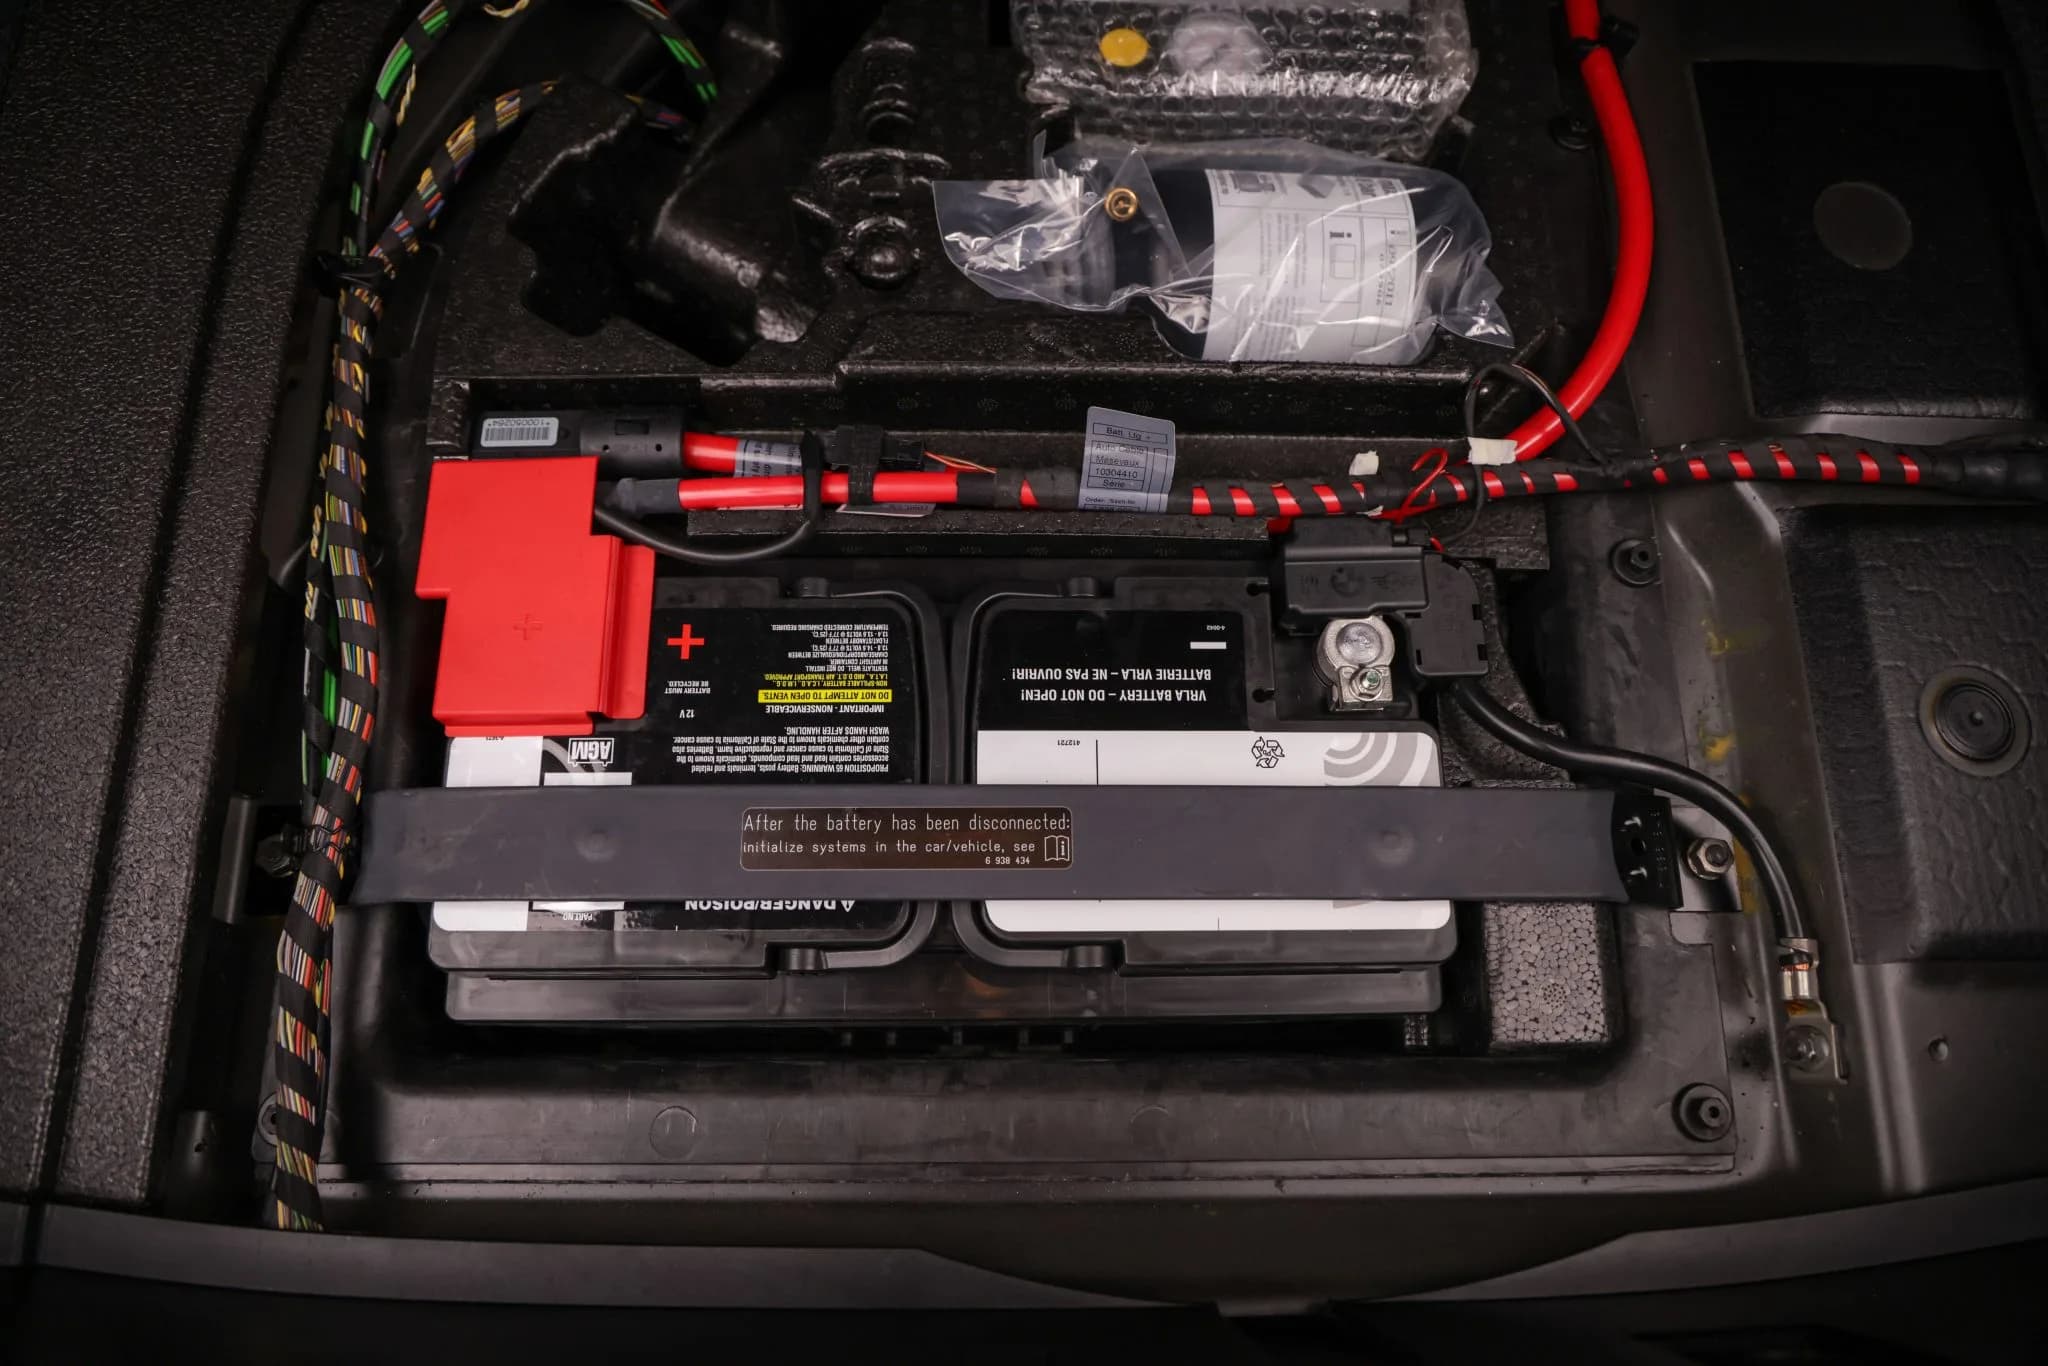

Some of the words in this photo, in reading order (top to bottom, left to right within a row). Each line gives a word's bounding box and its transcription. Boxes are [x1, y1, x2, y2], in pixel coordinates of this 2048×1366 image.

[1012, 668, 1062, 680] OUVRIR!
[1066, 668, 1089, 680] PAS
[1092, 668, 1108, 680] NE
[1121, 668, 1153, 680] VRLA
[1156, 668, 1211, 680] BATTERIE
[790, 691, 810, 700] OPEN
[813, 691, 822, 700] TO
[824, 691, 858, 700] ATTEMPT
[861, 691, 876, 700] NOT
[878, 691, 888, 700] DO
[1021, 689, 1057, 701] OPEN!
[1060, 689, 1084, 701] NOT
[1088, 689, 1105, 701] DO
[1119, 689, 1172, 701] BATTERY
[1175, 689, 1206, 701] VRLA
[765, 705, 833, 713] NONSERVICEABLE
[839, 705, 884, 713] IMPORTANT
[784, 726, 820, 735] HANDLING.
[822, 726, 843, 735] AFTER
[845, 726, 868, 735] HANDS
[870, 726, 889, 735] WASH
[673, 736, 695, 744] cancer.
[696, 736, 714, 744] cause
[716, 736, 721, 744] to
[723, 736, 752, 744] California
[753, 736, 759, 744] of
[761, 736, 777, 744] State
[778, 736, 788, 744] the
[789, 736, 795, 744] to
[796, 736, 816, 744] known
[817, 736, 848, 744] chemicals
[850, 736, 865, 744] other
[867, 736, 889, 744] contain
[571, 741, 611, 760] AGM
[672, 746, 685, 754] also
[687, 746, 714, 754] Batteries
[715, 746, 733, 754] harm.
[734, 744, 772, 754] reproductive
[774, 745, 785, 754] and
[786, 745, 806, 754] cancer
[808, 745, 826, 754] cause
[828, 745, 833, 754] to
[835, 745, 864, 754] California
[866, 745, 872, 754] of
[873, 745, 889, 754] State
[676, 755, 686, 764] the
[688, 755, 694, 764] to
[694, 755, 714, 764] known
[716, 755, 747, 764] chemicals
[748, 754, 786, 763] compounds,
[787, 754, 800, 763] lead
[802, 754, 813, 763] and
[814, 754, 828, 763] lead
[829, 754, 852, 763] contain
[853, 754, 889, 763] accessories
[691, 765, 713, 773] related
[714, 765, 726, 773] and
[727, 765, 756, 773] terminals
[777, 763, 799, 773] Battery
[836, 764, 843, 773] 65
[844, 764, 888, 773] PROPOSITION
[744, 813, 784, 831] After
[794, 813, 817, 831] the
[827, 813, 882, 834] battery
[892, 813, 916, 831] has
[926, 813, 959, 830] been
[969, 813, 1070, 830] disconnected:
[743, 840, 804, 853] initialize
[812, 840, 866, 855] systems
[875, 841, 887, 852] in
[896, 839, 917, 852] the
[925, 839, 1005, 854] car/vehicle,
[1013, 842, 1035, 852] see
[985, 856, 991, 865] 6
[995, 856, 1011, 865] 938
[1015, 856, 1030, 865] 434
[685, 900, 836, 910] DANGER/POISON
